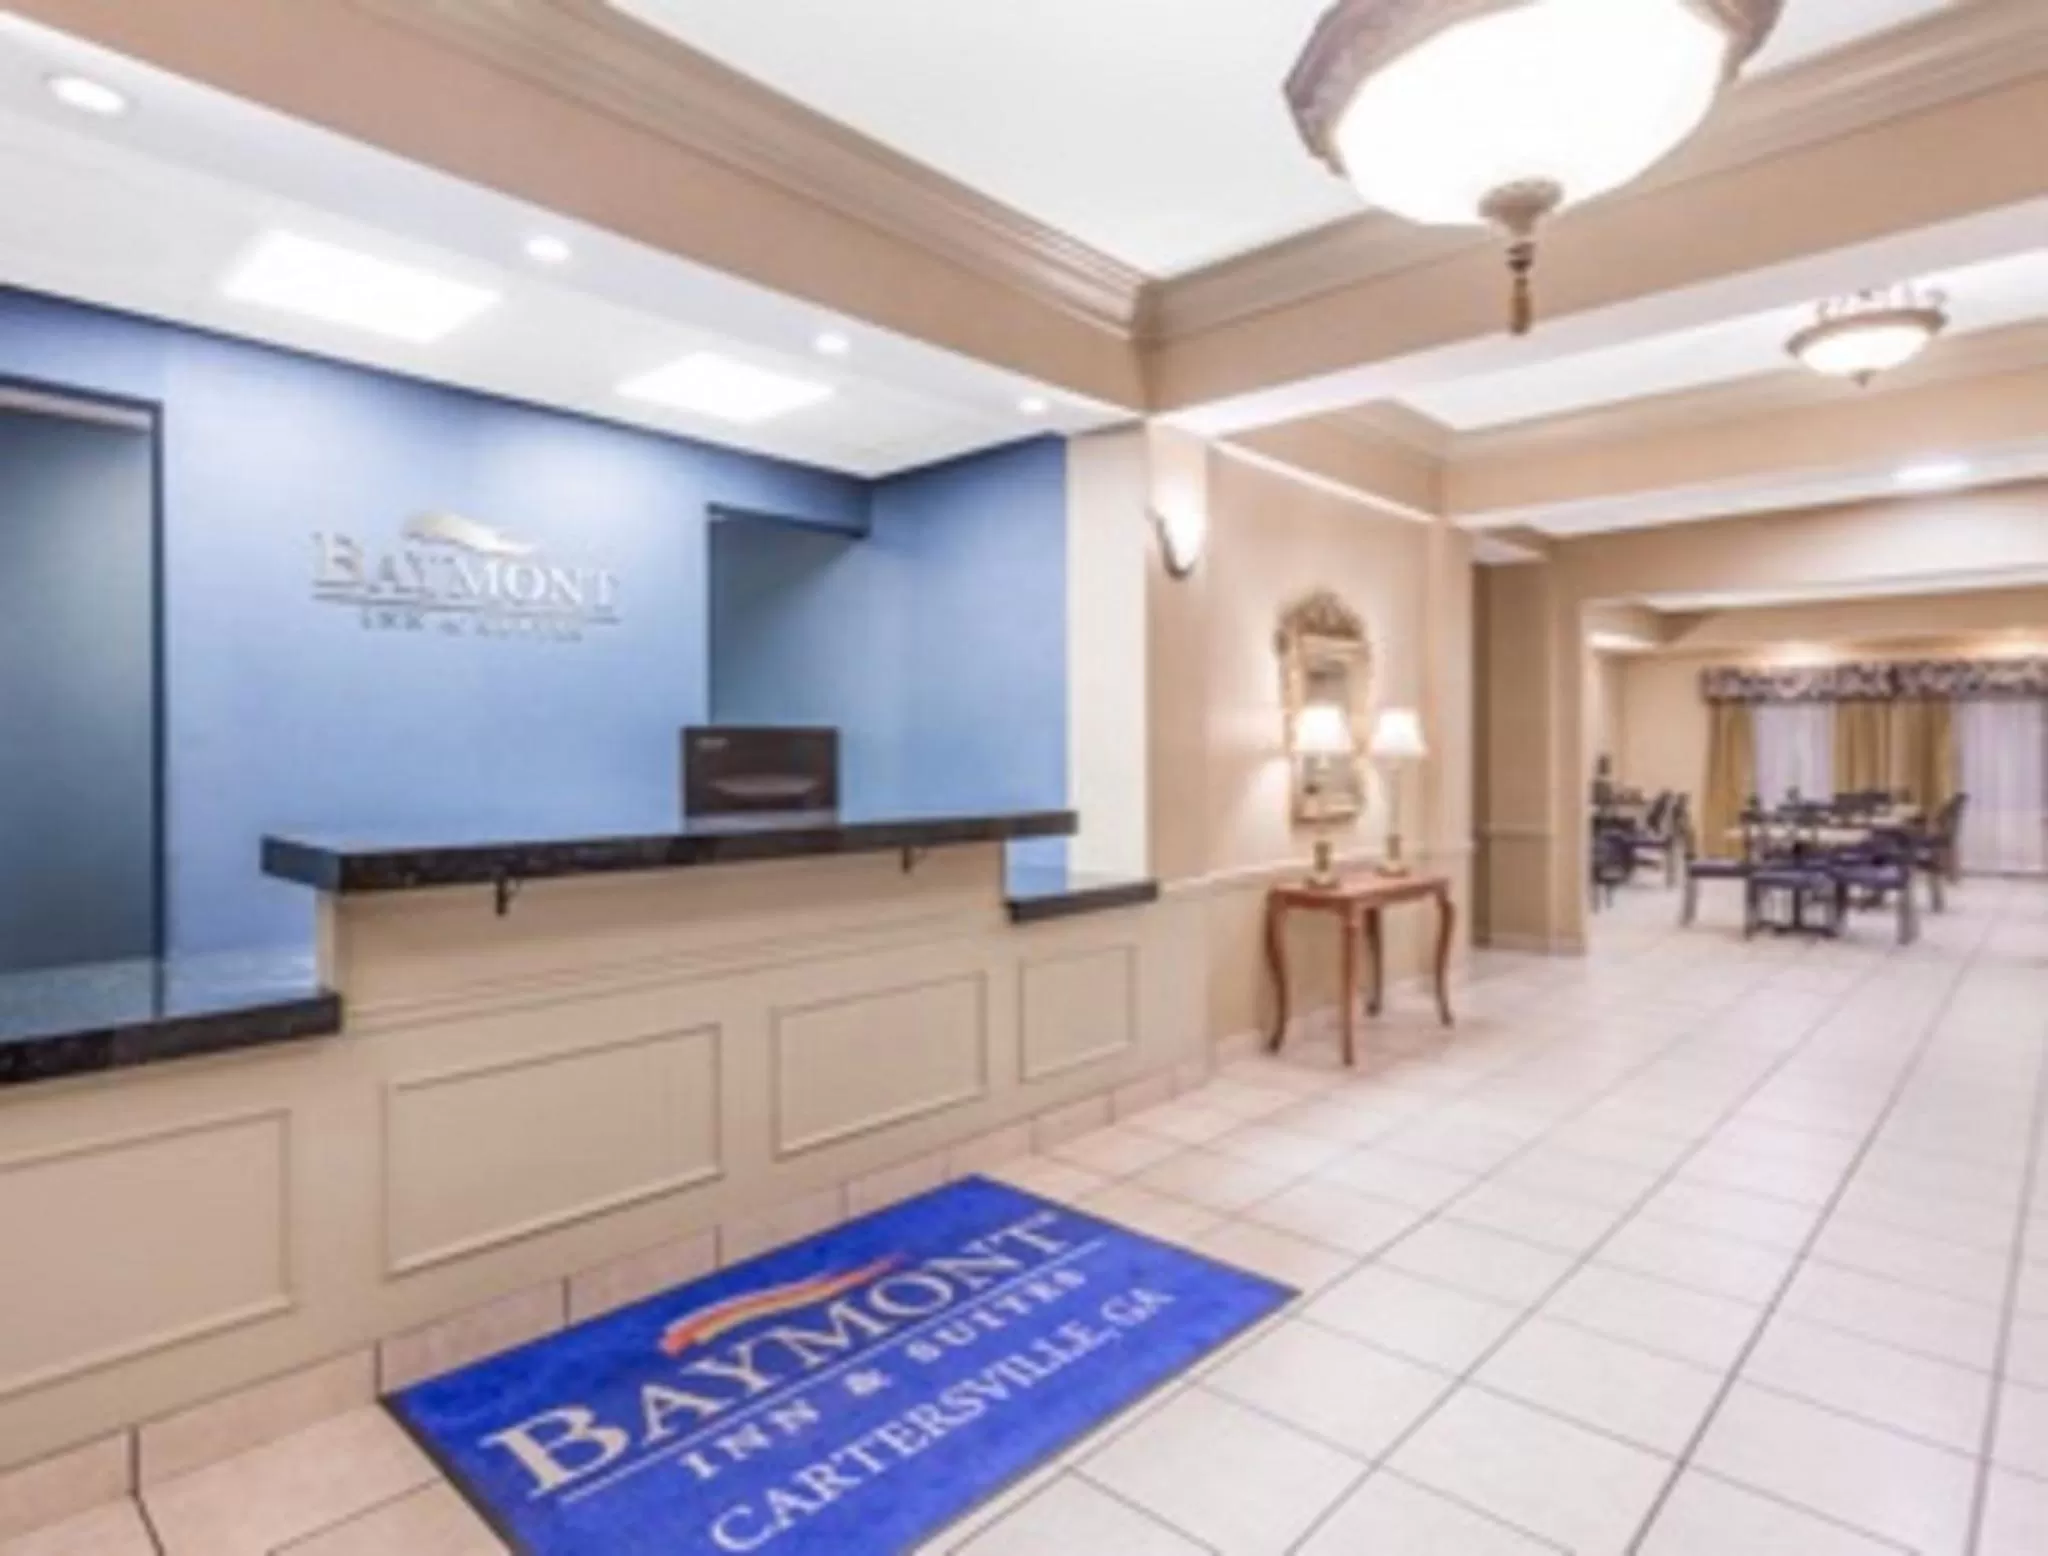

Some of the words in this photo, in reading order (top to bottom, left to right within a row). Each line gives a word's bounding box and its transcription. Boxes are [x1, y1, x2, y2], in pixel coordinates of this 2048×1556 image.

[478, 1212, 1066, 1500] BAYMONT
[678, 1400, 820, 1480] INN
[844, 1368, 892, 1397] &
[905, 1268, 1086, 1364] SUITES
